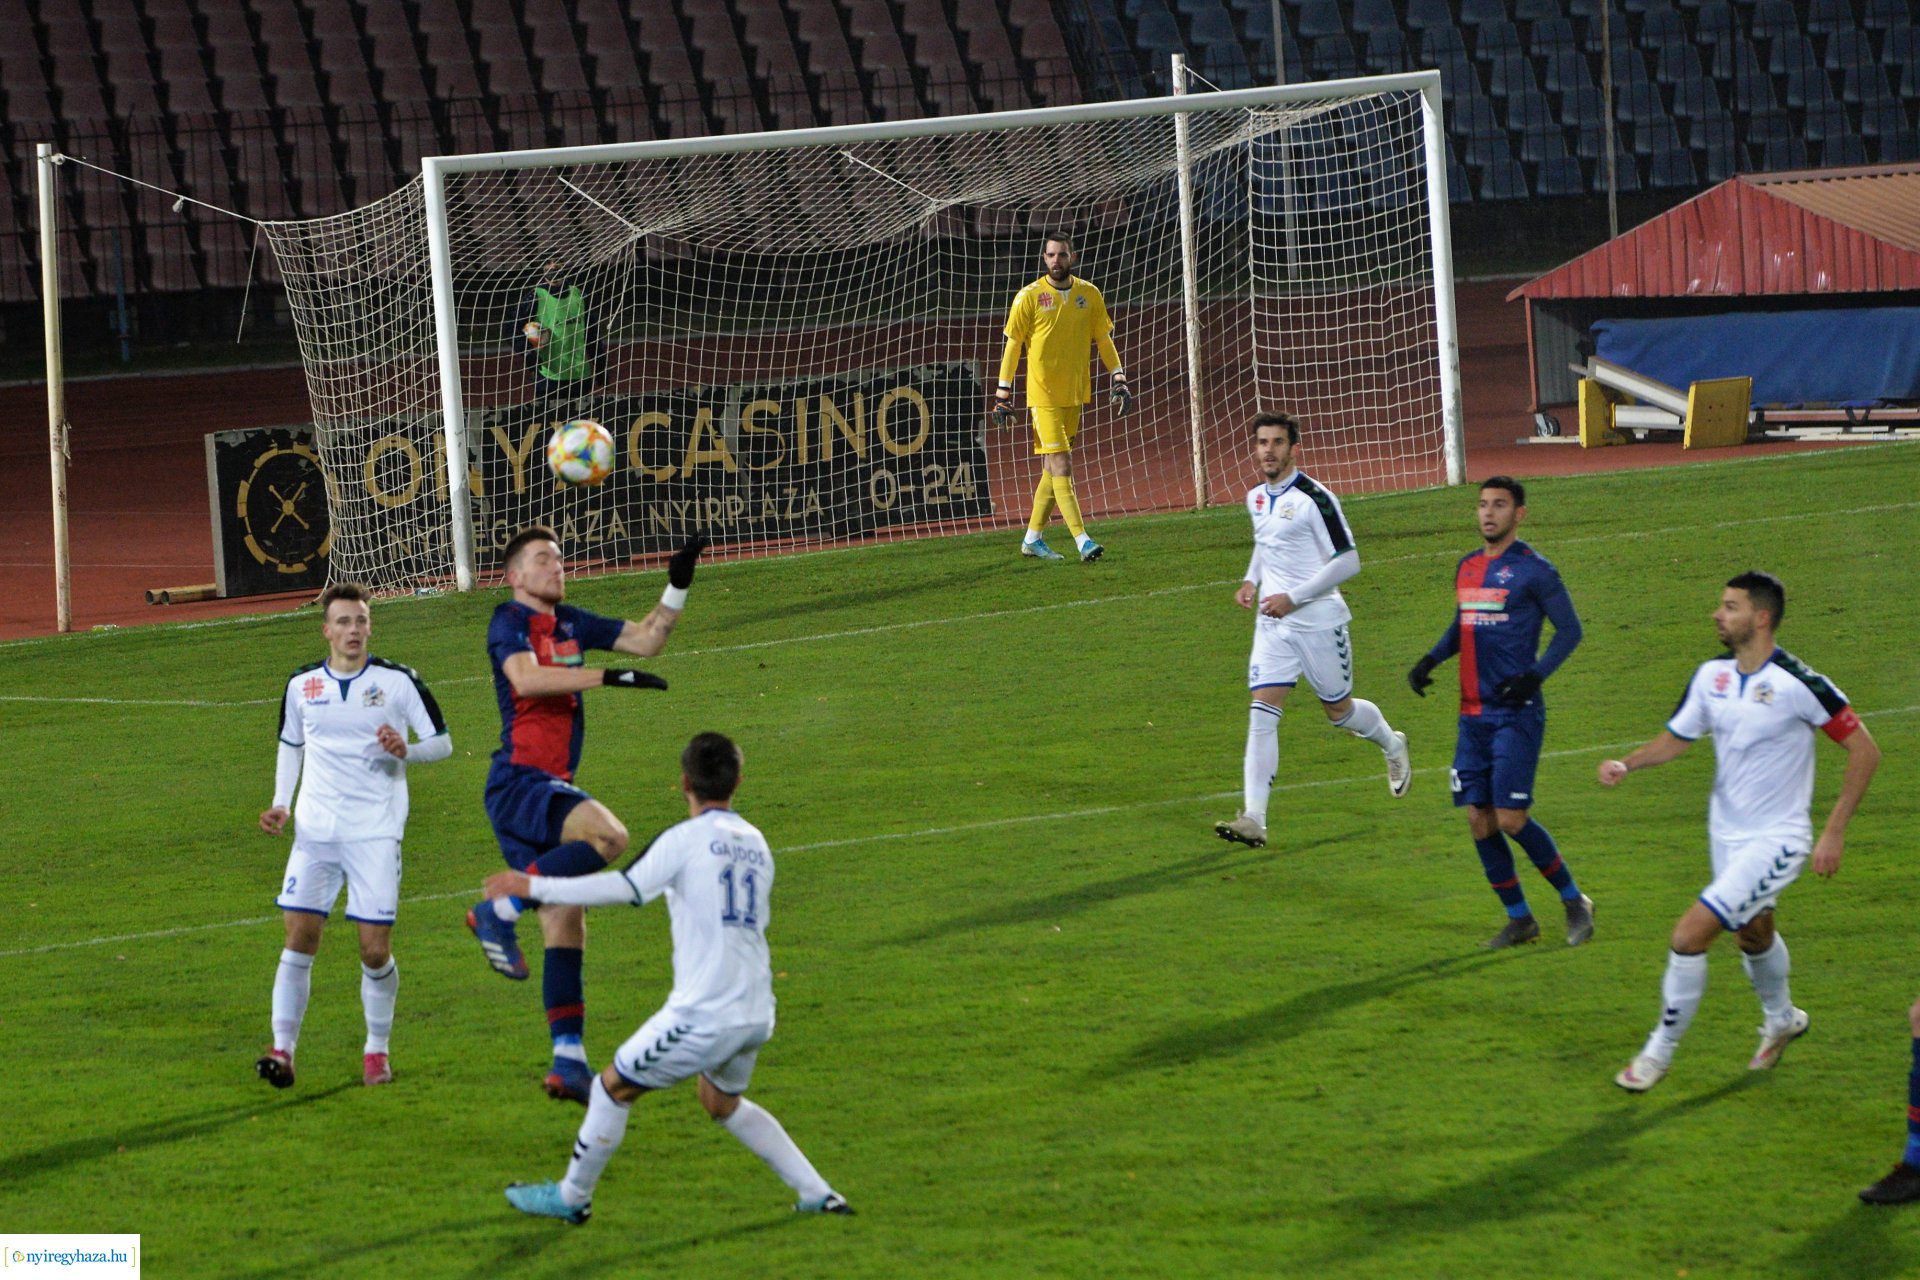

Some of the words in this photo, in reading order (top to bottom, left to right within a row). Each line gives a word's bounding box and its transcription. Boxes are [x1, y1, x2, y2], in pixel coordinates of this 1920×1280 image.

[364, 417, 605, 508] ONY
[628, 386, 931, 482] CASINO
[869, 461, 977, 510] 0-24
[286, 876, 297, 895] 2
[719, 864, 758, 931] 11
